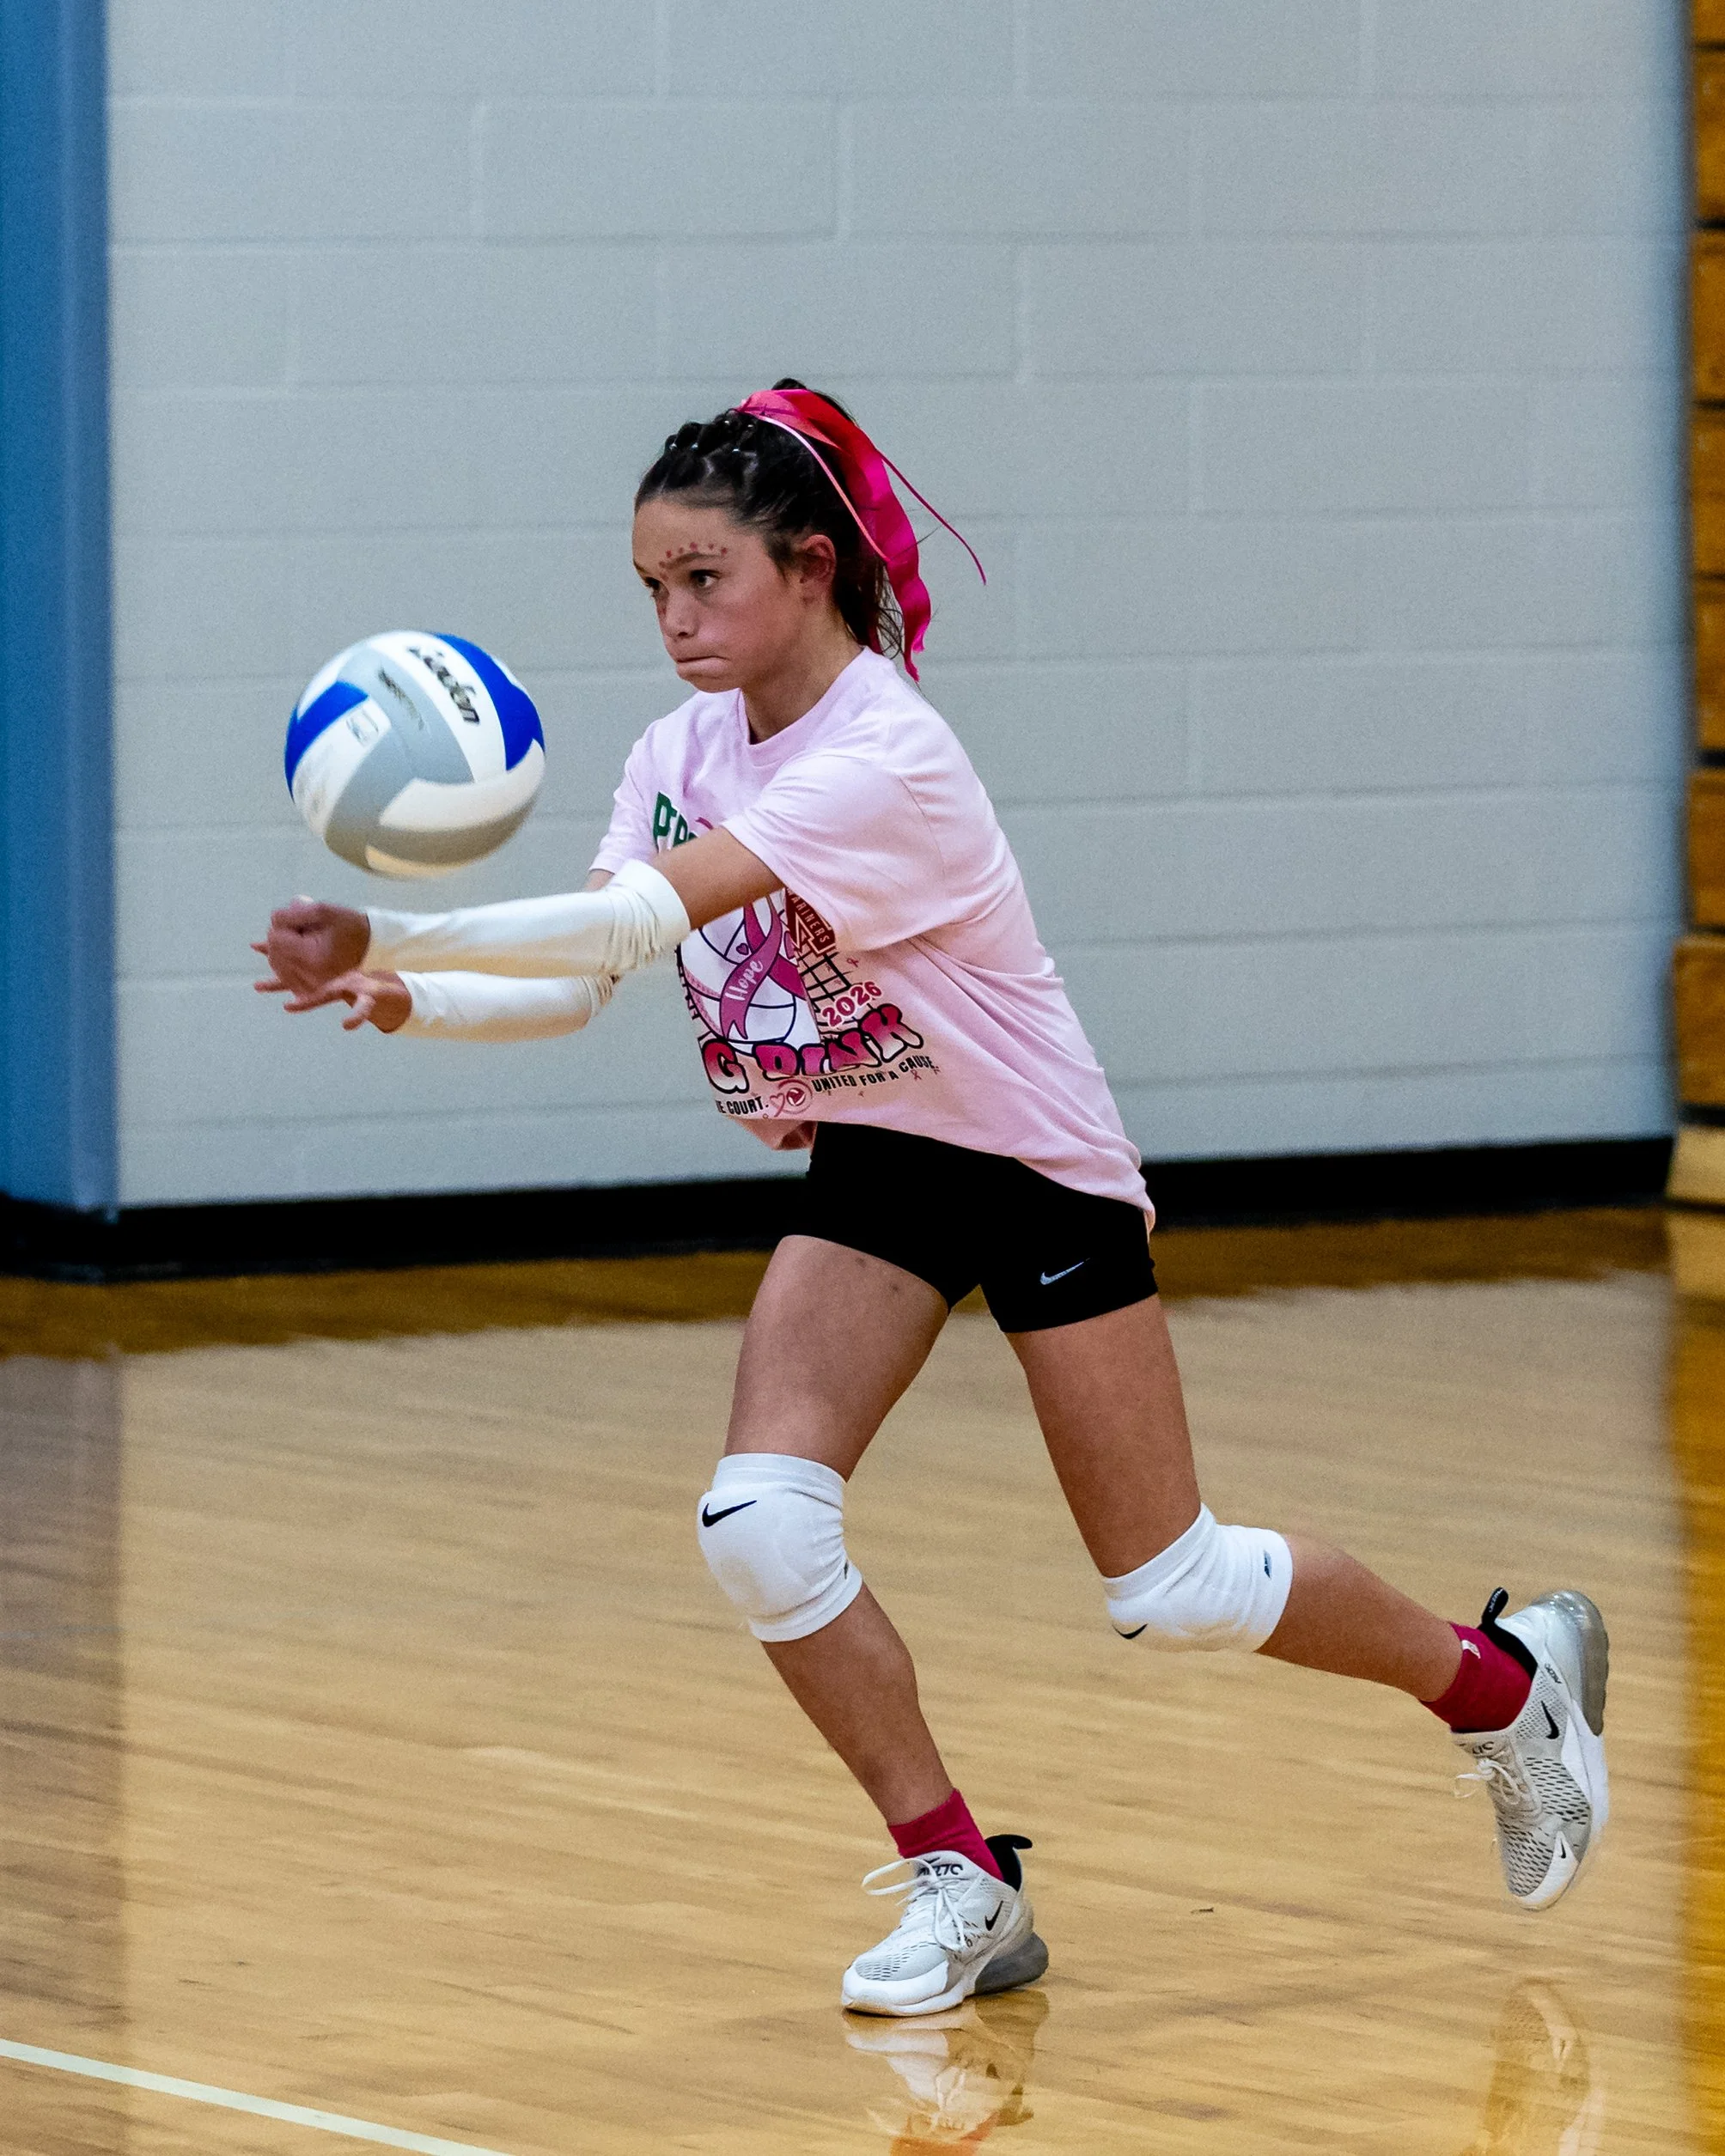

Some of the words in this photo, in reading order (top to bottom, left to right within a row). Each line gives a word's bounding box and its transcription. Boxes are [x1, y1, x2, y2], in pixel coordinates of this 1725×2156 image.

[724, 959, 764, 1002] Hope
[821, 980, 883, 1028] 2026
[726, 1096, 769, 1115] COURT.
[811, 1074, 857, 1093] UNITED
[858, 1072, 887, 1087] FOR
[887, 1070, 899, 1081] A
